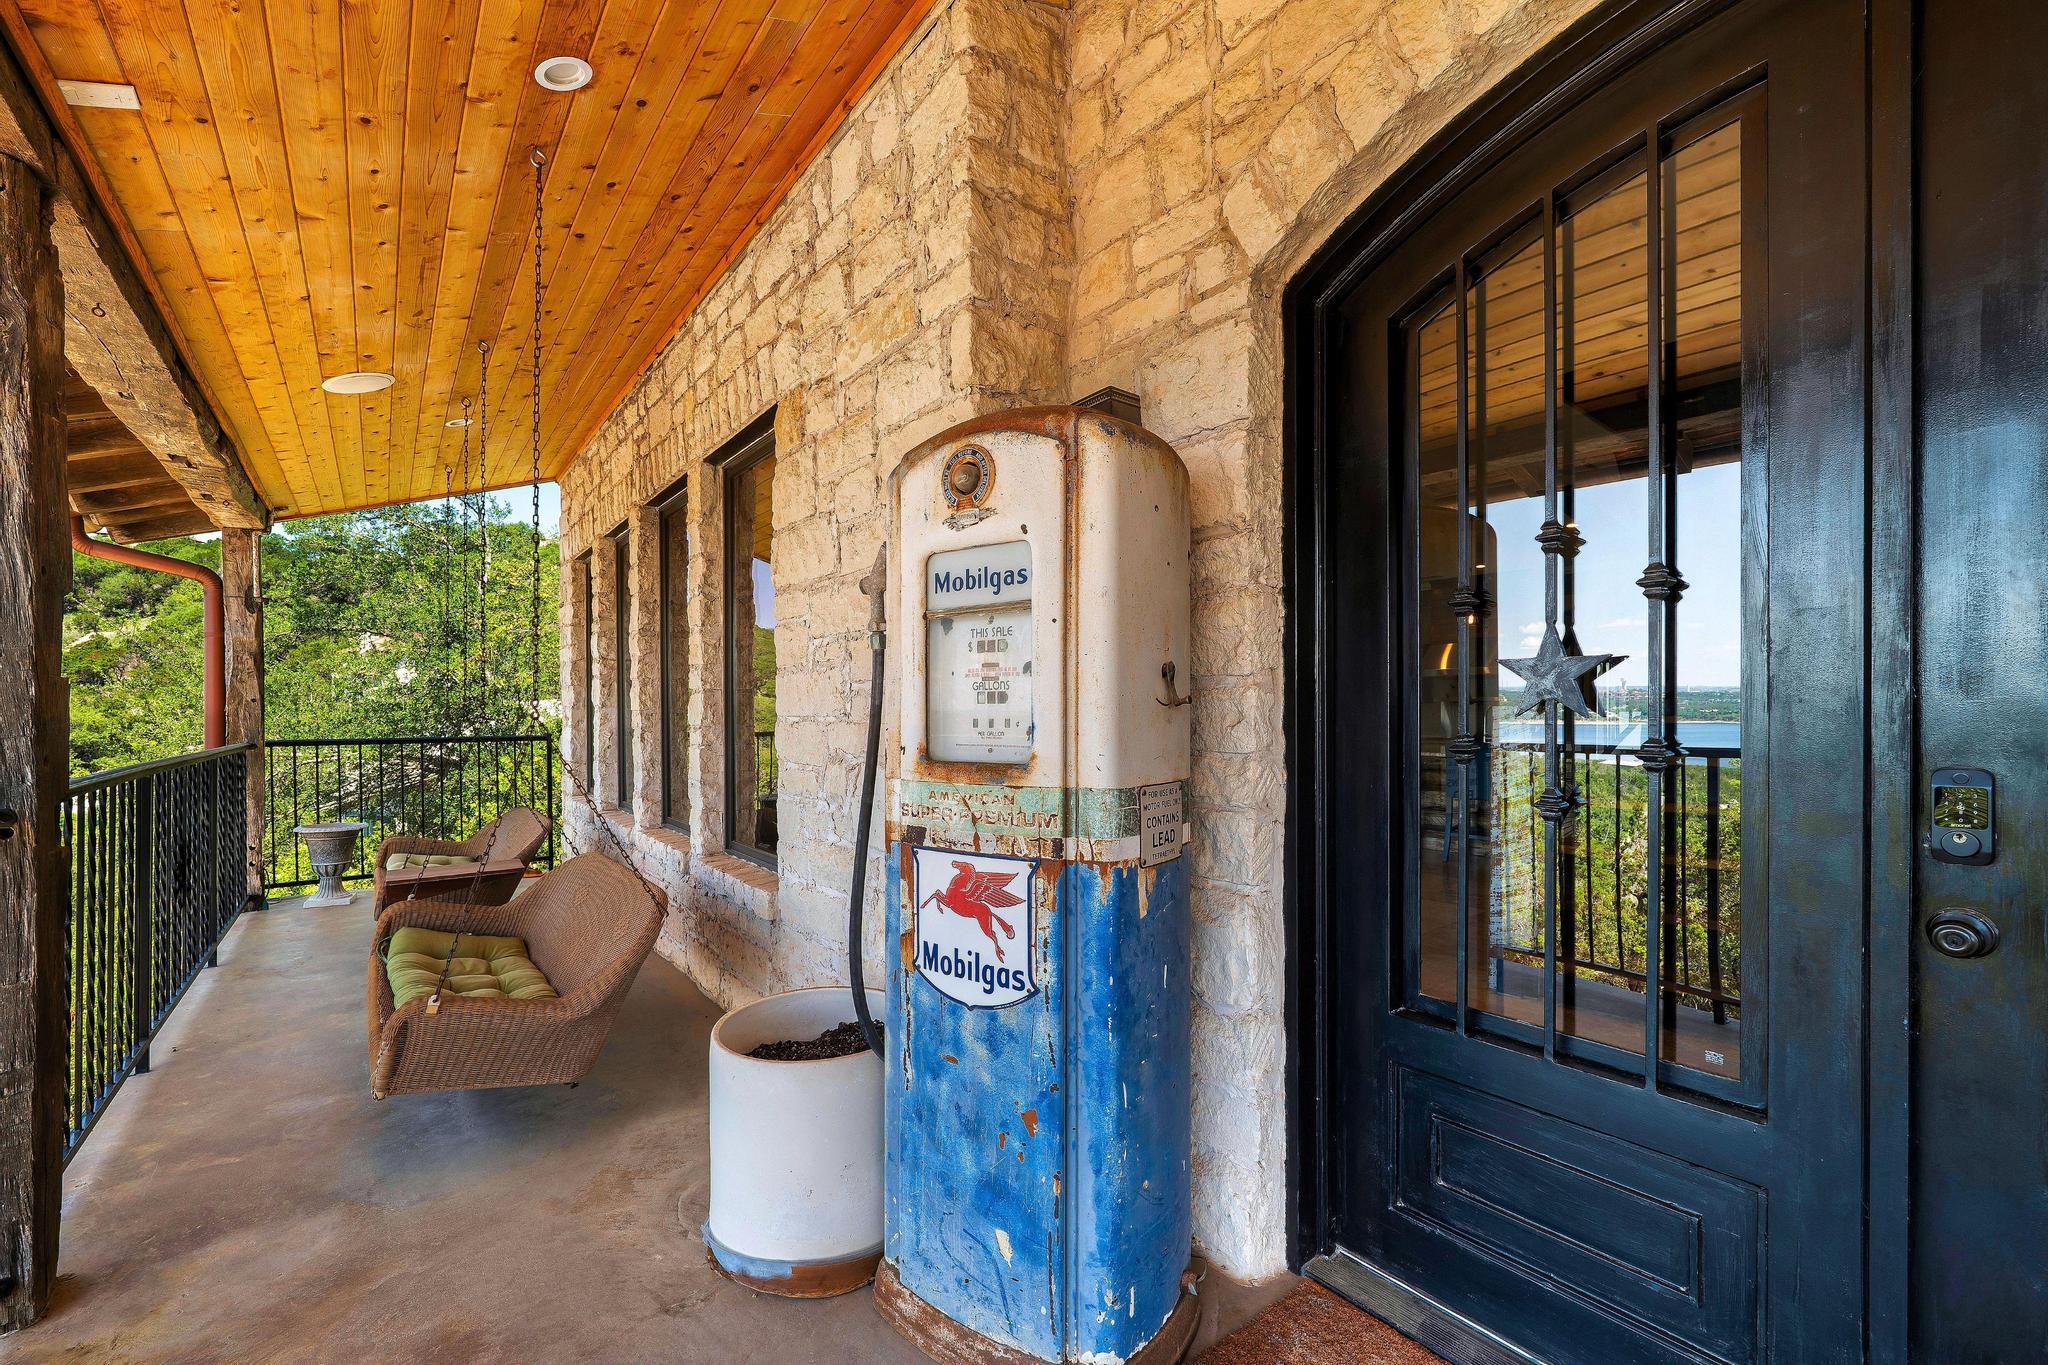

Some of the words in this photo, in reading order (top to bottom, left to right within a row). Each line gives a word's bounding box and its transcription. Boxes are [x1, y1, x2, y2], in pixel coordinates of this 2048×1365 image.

[934, 566, 1028, 595] Mobilgas
[970, 628, 988, 638] THIS
[992, 626, 1013, 637] SALE
[972, 680, 1010, 691] GALLONS
[928, 790, 1015, 806] AMERICAN
[1148, 790, 1158, 799] FOR
[1159, 789, 1168, 798] USE
[1143, 802, 1160, 811] MOTOR
[1162, 799, 1172, 808] FUEL
[1146, 811, 1180, 829] CONTAINS
[1152, 829, 1176, 848] LEAD
[923, 940, 1026, 994] Mobilgas
